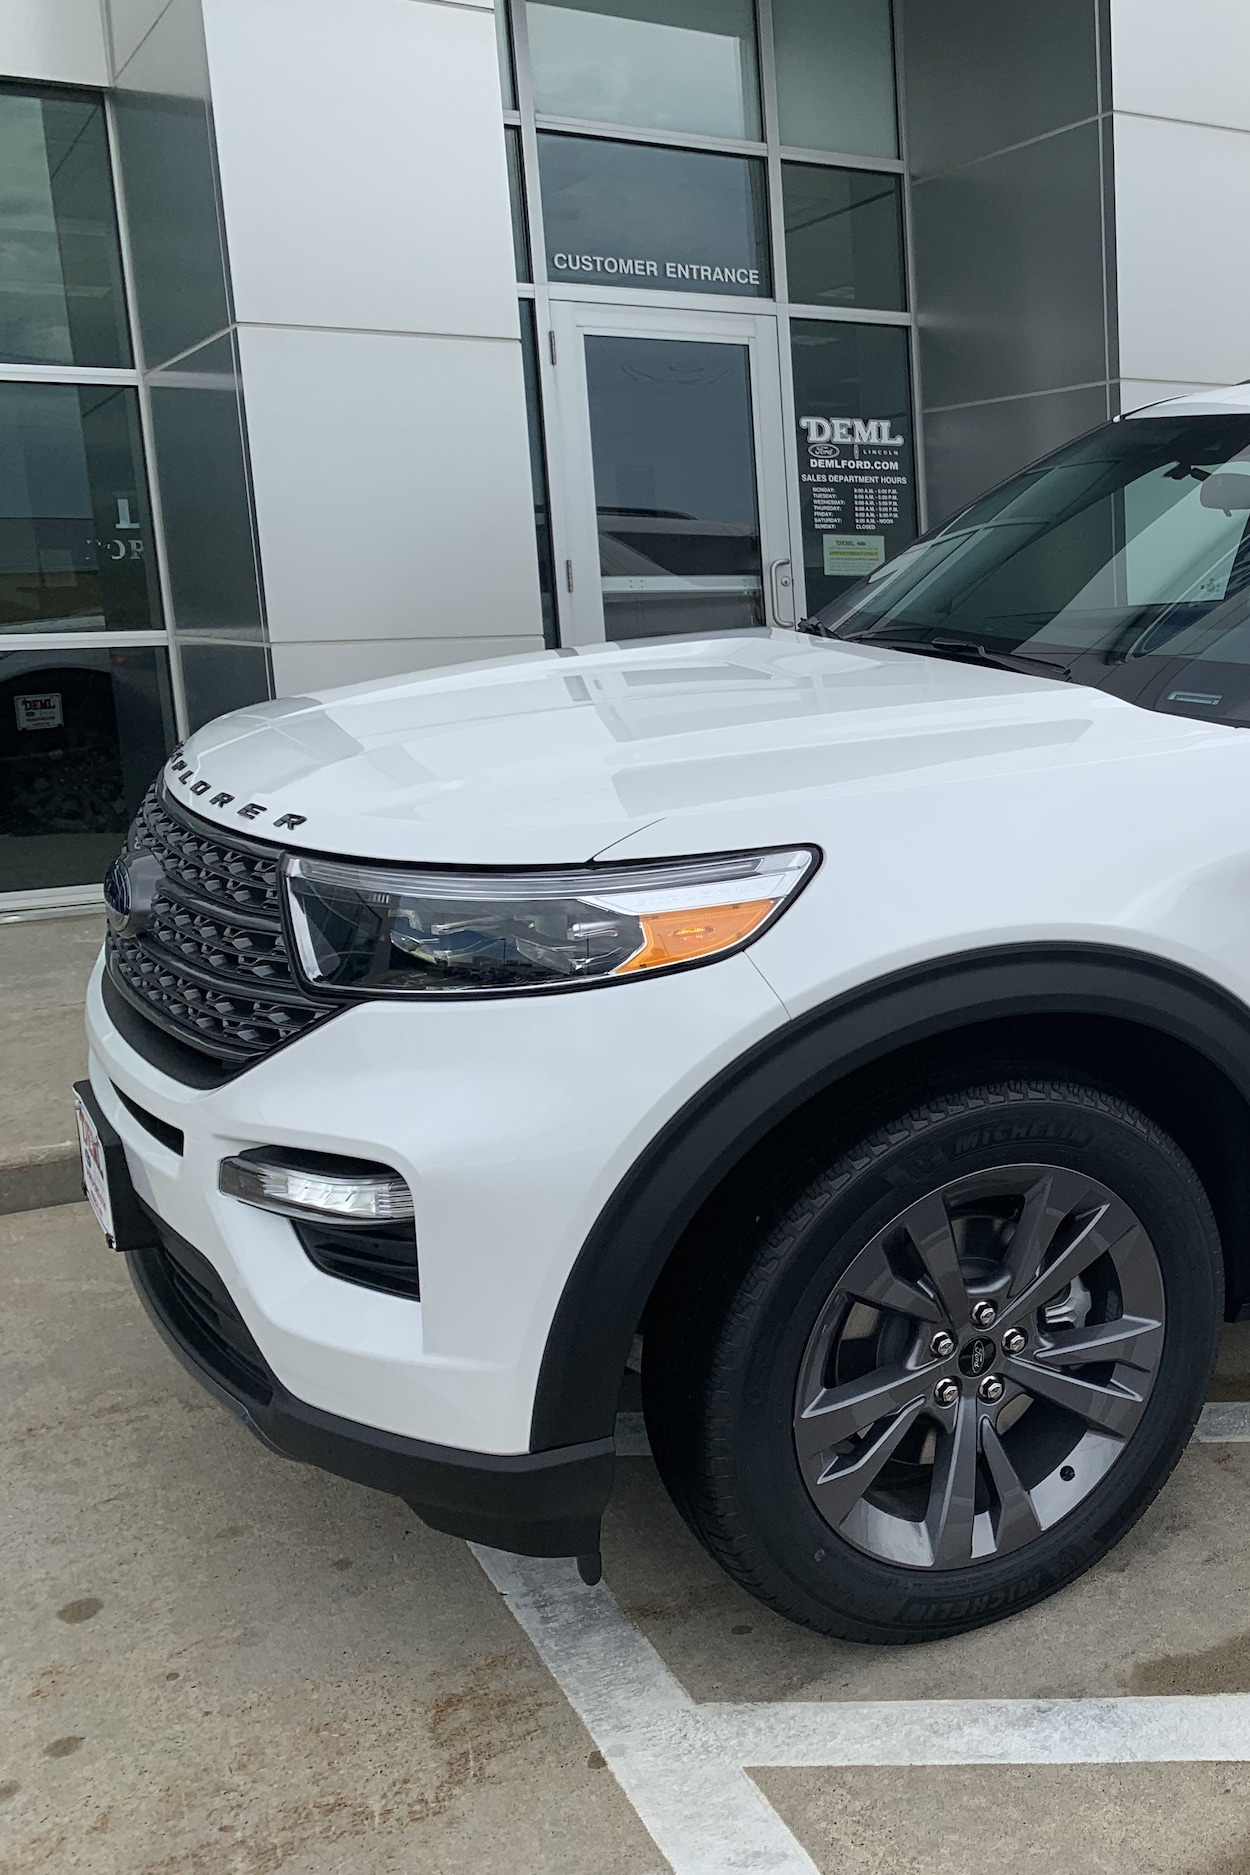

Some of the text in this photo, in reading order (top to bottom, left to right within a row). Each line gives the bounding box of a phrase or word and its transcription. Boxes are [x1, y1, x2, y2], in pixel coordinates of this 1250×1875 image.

[553, 253, 760, 285] CUSTOMER ENTRANCE
[799, 416, 904, 446] DEML
[801, 474, 908, 485] SALES DEPARTMENT HOURS
[809, 458, 899, 470] DEMLFORD.COM
[954, 1119, 1092, 1152] MICHELIN
[902, 1572, 1041, 1621] MICHELIN
